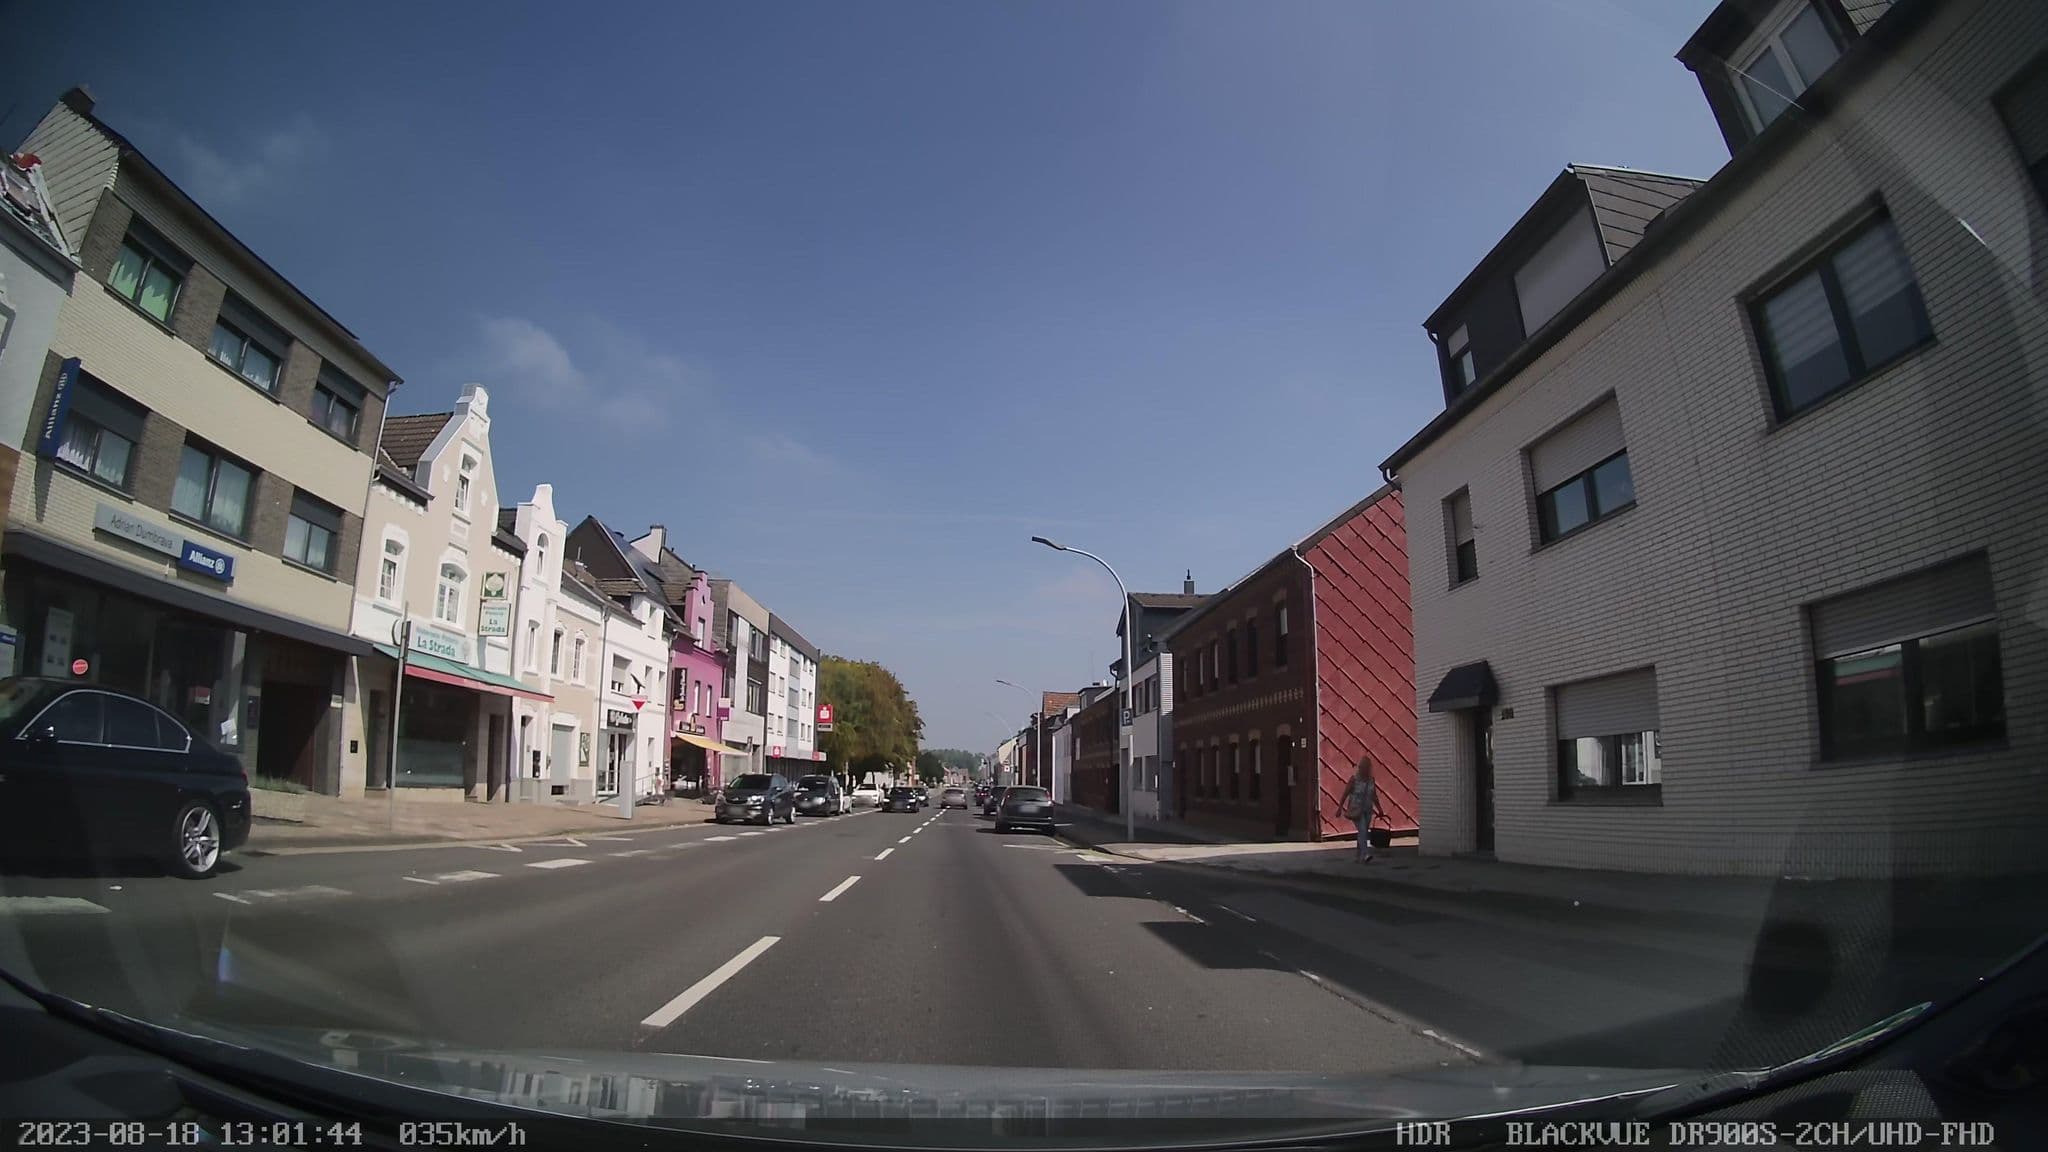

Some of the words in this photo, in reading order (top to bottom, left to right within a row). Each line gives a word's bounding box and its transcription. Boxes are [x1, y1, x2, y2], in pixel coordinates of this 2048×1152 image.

[45, 392, 61, 440] Allianz
[188, 549, 216, 570] Allianz
[417, 635, 427, 649] La
[429, 639, 456, 657] Strada
